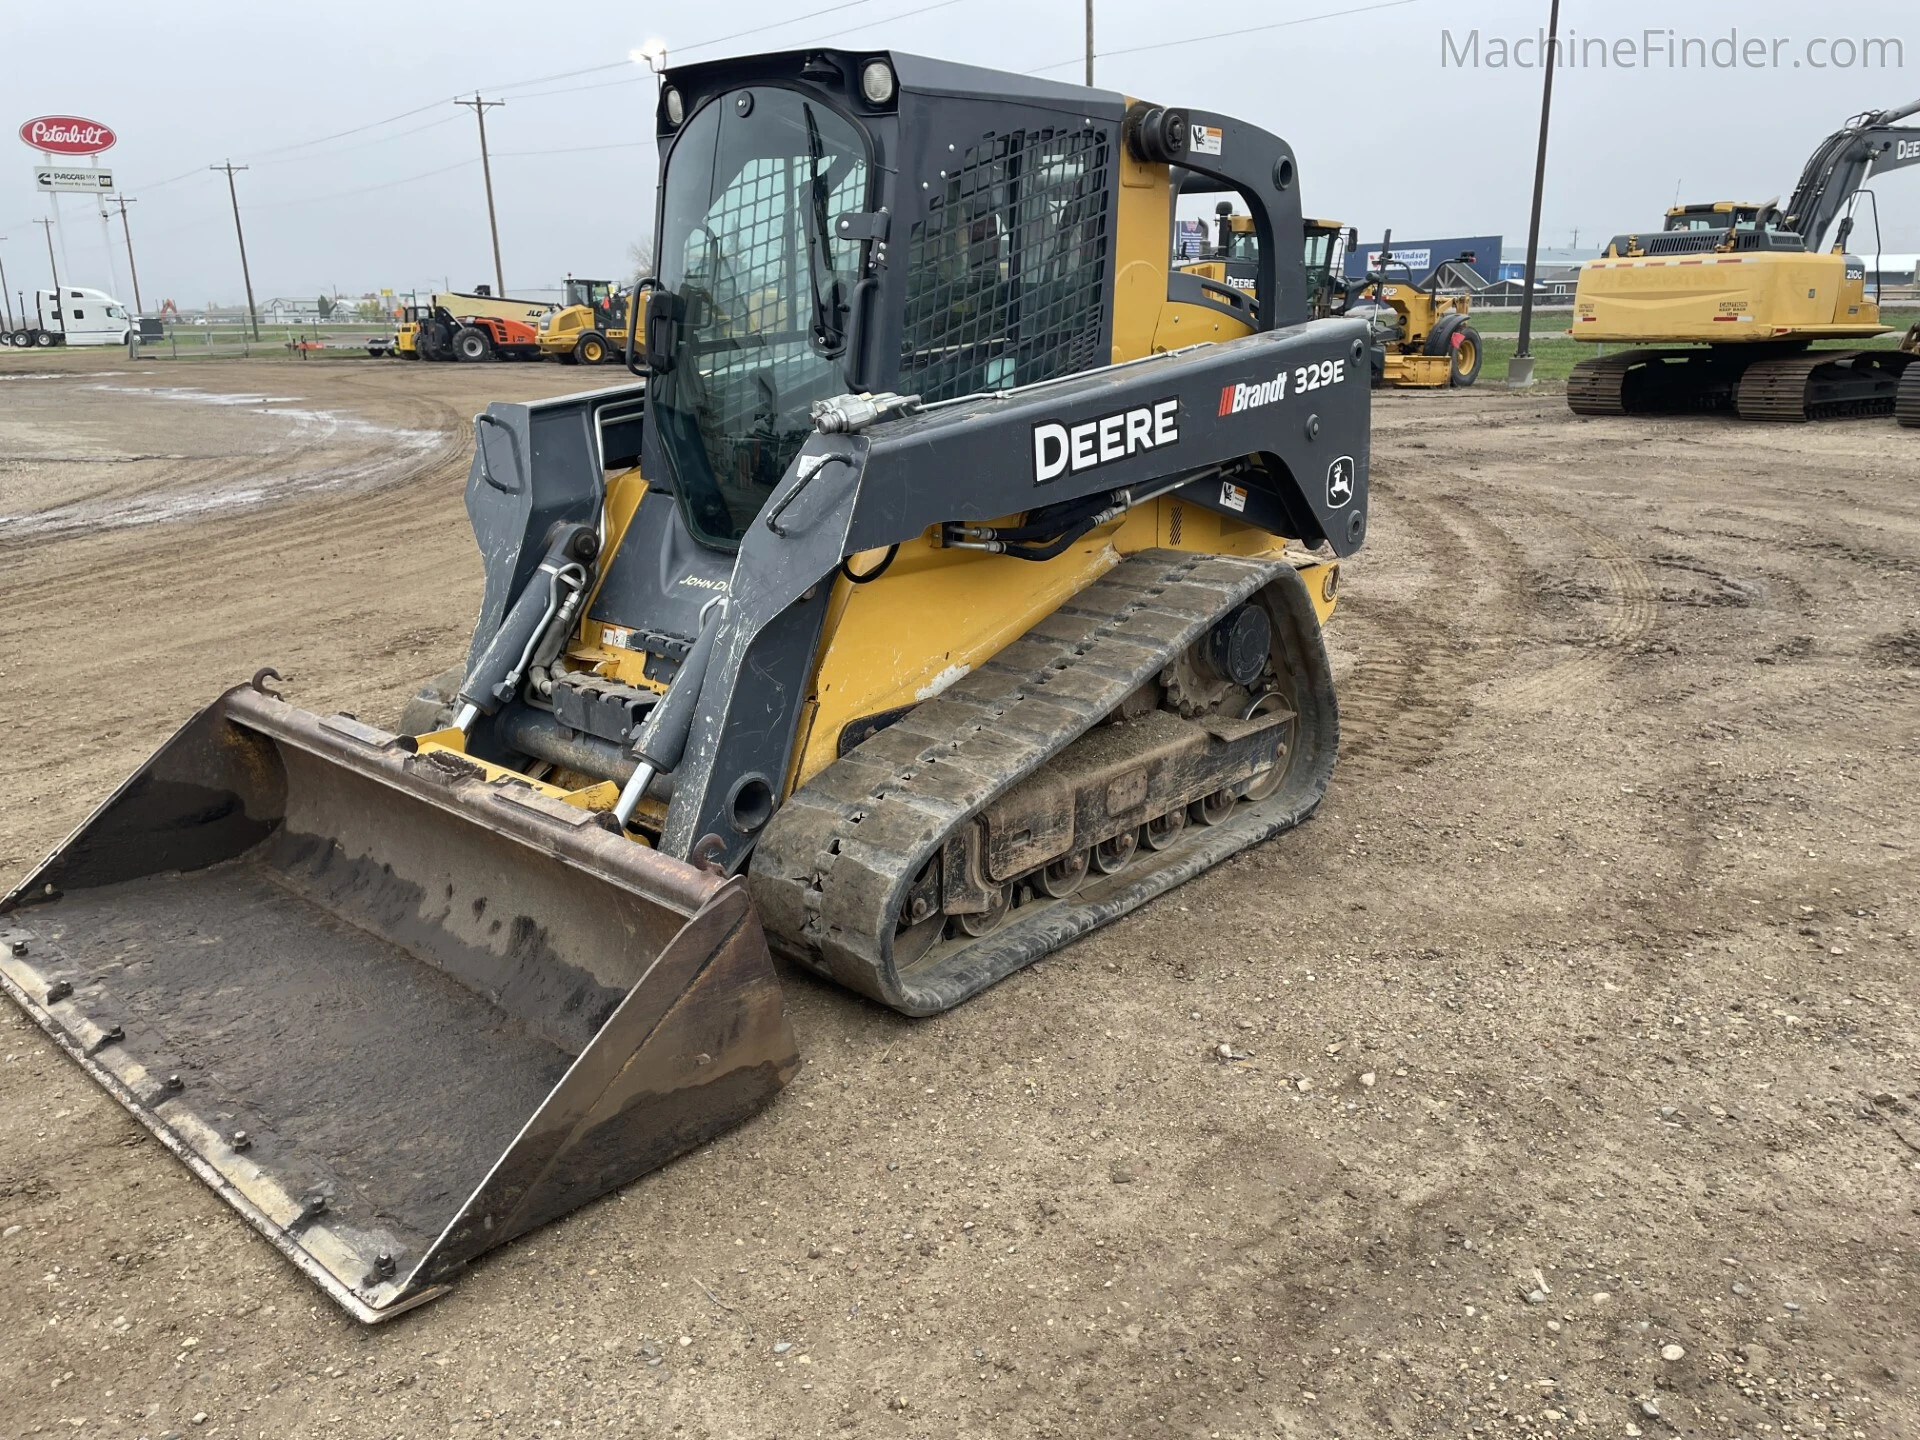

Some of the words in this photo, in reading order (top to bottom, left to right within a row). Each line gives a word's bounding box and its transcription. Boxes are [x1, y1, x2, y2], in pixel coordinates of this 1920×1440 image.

[31, 121, 107, 144] Peterbilt
[1394, 251, 1428, 260] Windsor
[1226, 275, 1256, 289] DEERE
[526, 310, 543, 318] JLG
[1294, 359, 1345, 394] 329E
[1231, 371, 1287, 413] Brandt
[1034, 399, 1179, 483] DEERE
[679, 574, 715, 589] JOHN
